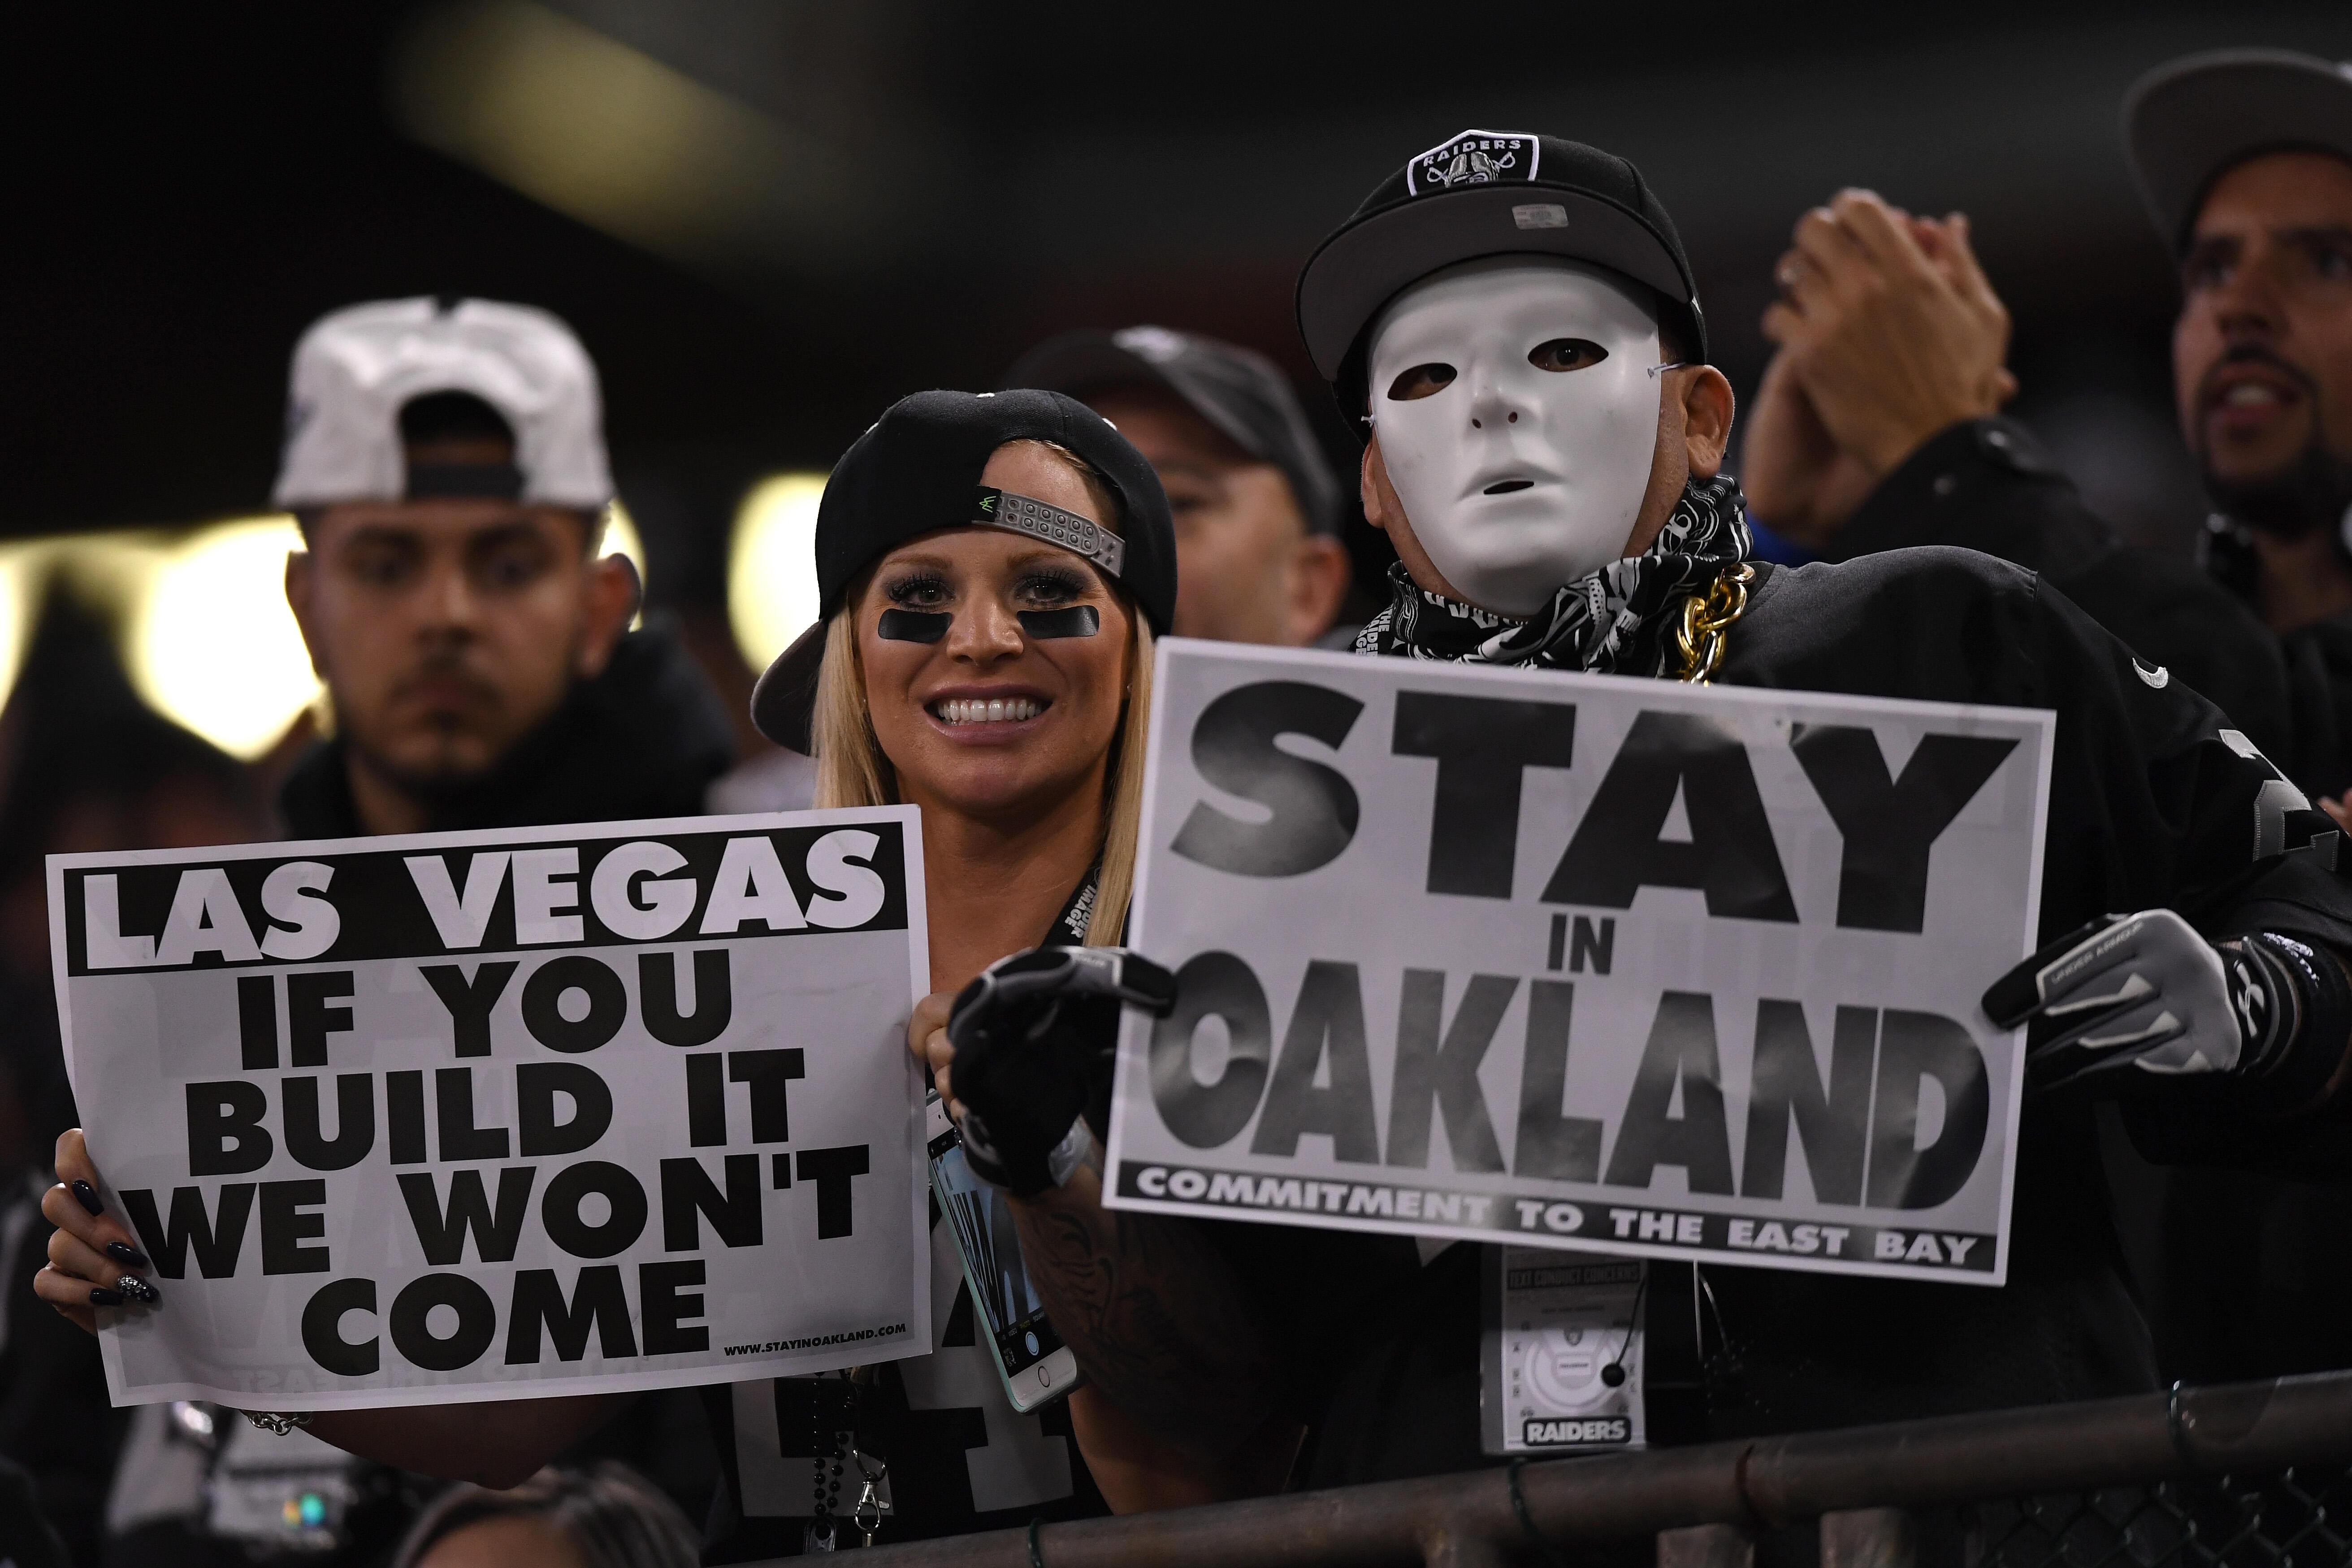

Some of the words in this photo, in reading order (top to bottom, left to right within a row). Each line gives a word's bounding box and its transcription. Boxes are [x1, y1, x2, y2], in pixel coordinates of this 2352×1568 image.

[1423, 140, 1521, 167] RAIDERS
[1169, 679, 2022, 934] STAY
[83, 861, 341, 969] LAS
[403, 829, 885, 949] VEGAS
[1065, 884, 1097, 927] IMAGE
[1547, 913, 1615, 975] IN
[237, 970, 355, 1071] IF
[417, 949, 732, 1058] YOU
[185, 1061, 613, 1177] BUILD
[686, 1048, 805, 1148] IT
[1147, 950, 1989, 1211] OAKLAND
[118, 1178, 330, 1279] WE
[396, 1144, 869, 1265] WON'T
[1136, 1166, 1493, 1224] COMMITMENT
[1516, 1201, 1584, 1232] TO
[1610, 1208, 1703, 1244] THE
[1727, 1219, 1850, 1255] EAST
[1874, 1231, 1978, 1266] BAY
[301, 1259, 710, 1376] COME
[724, 1323, 906, 1356] WWW.STAYINOAKLAND.COM
[1526, 1419, 1626, 1442] RAIDERS
